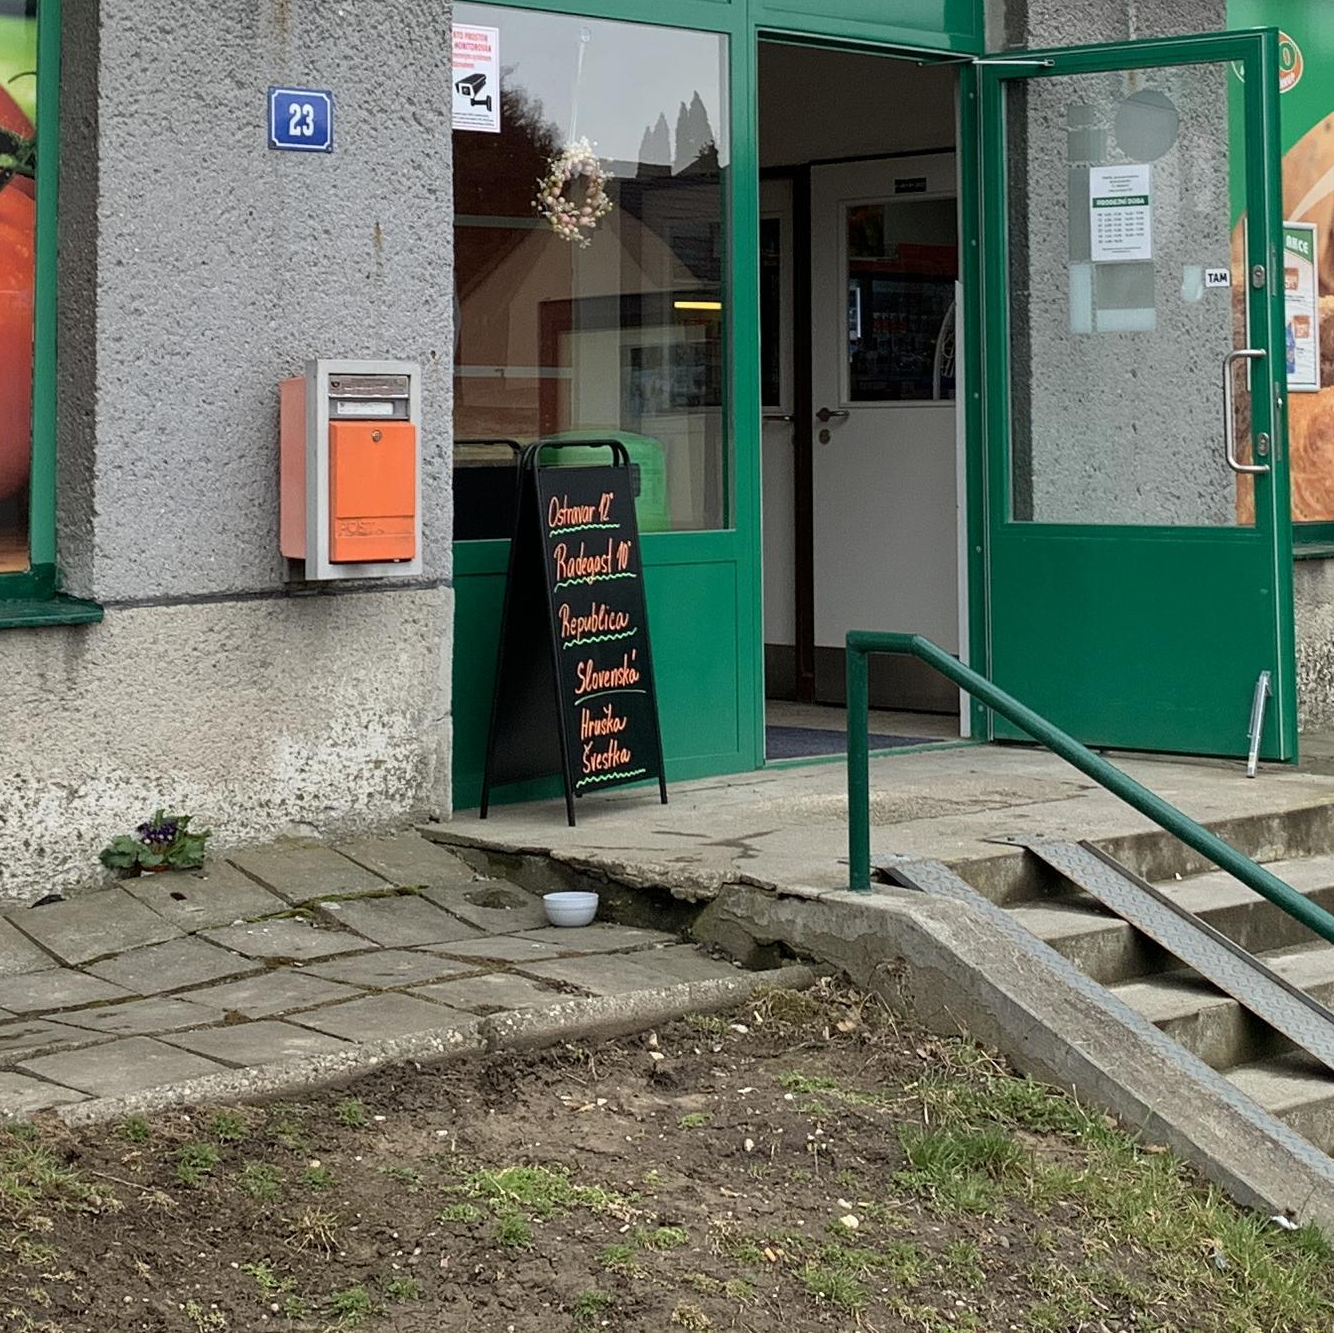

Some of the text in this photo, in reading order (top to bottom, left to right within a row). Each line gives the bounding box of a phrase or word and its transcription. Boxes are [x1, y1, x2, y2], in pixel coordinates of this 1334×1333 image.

[288, 103, 314, 136] 23
[1208, 273, 1228, 283] TAM
[548, 495, 596, 527] Ostravar
[554, 538, 612, 586] Radegast
[559, 603, 629, 642] Republica
[574, 649, 640, 695] Slovenská
[581, 704, 627, 739] Hruška
[582, 739, 631, 774] Švestka
